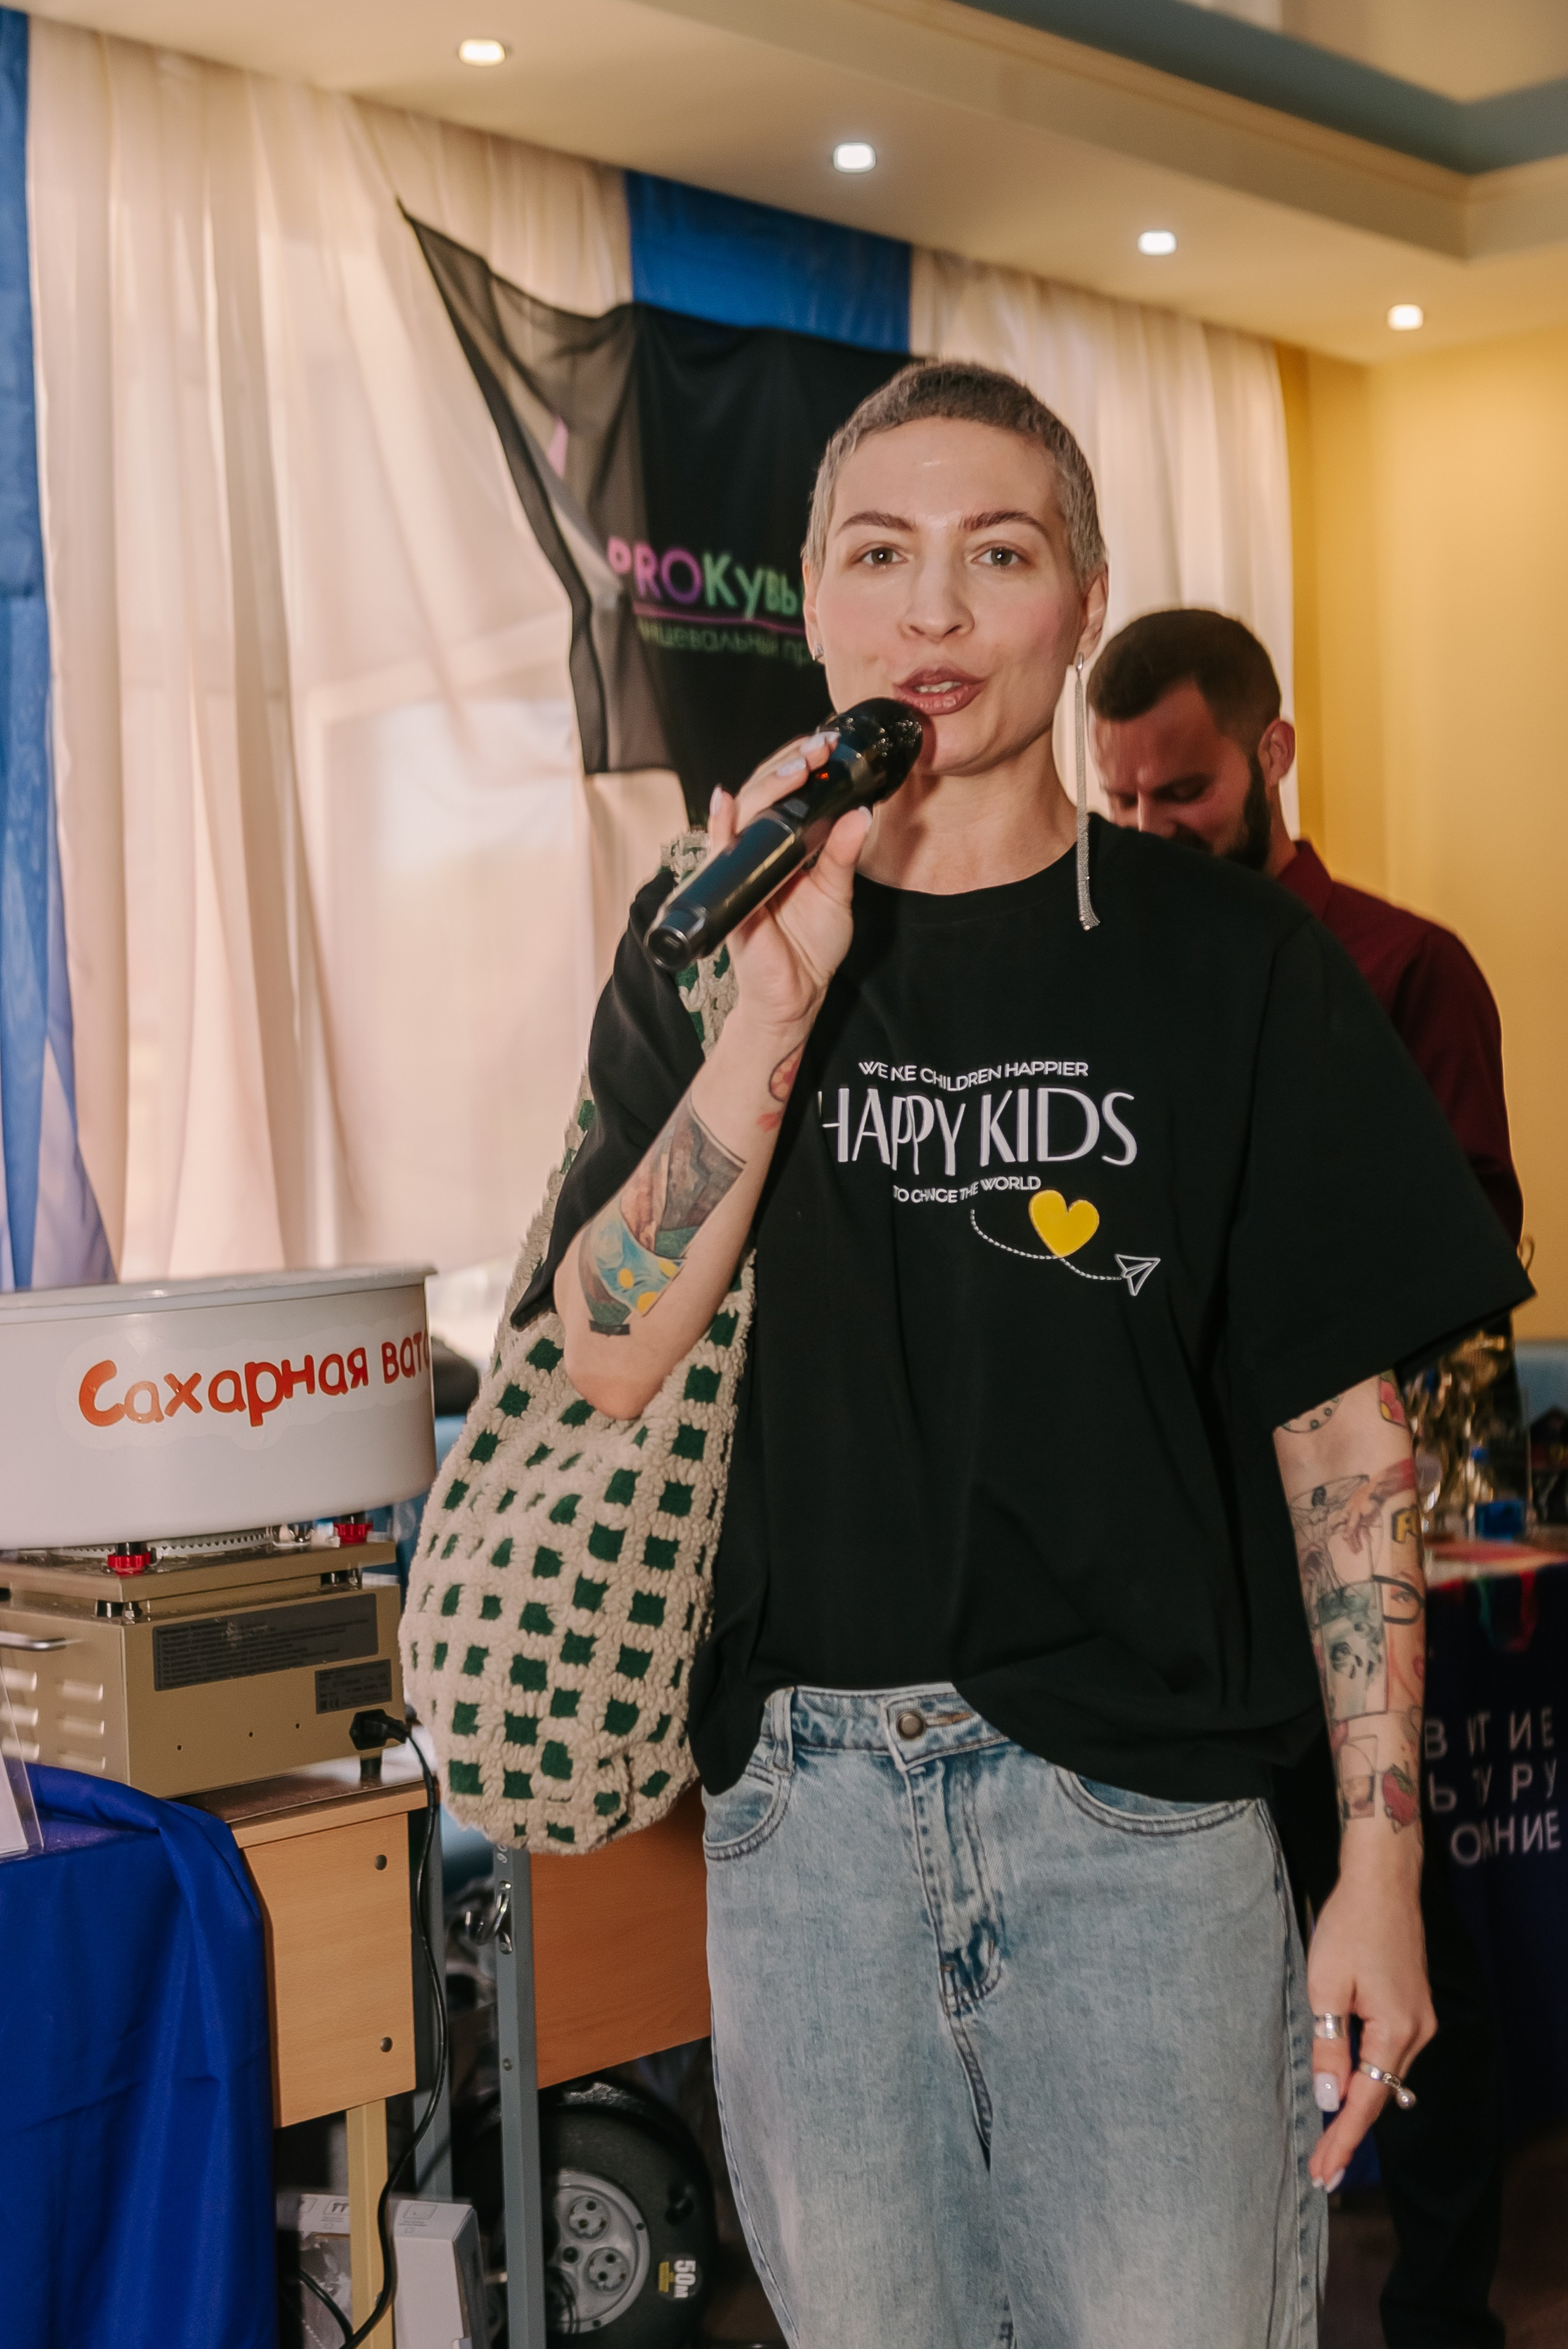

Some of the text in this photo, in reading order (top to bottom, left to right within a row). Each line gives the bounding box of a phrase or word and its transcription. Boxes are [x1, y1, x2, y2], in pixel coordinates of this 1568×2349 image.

[858, 1061, 888, 1078] WE
[920, 1065, 1001, 1091] CHILDREN
[1005, 1061, 1088, 1076] HAPPIER
[818, 1088, 1137, 1176] HAPPY KIDS
[893, 1184, 909, 1201] TO
[960, 1181, 979, 1200] THE
[980, 1176, 1041, 1190] WORLD
[79, 1347, 369, 1427] Сахарная
